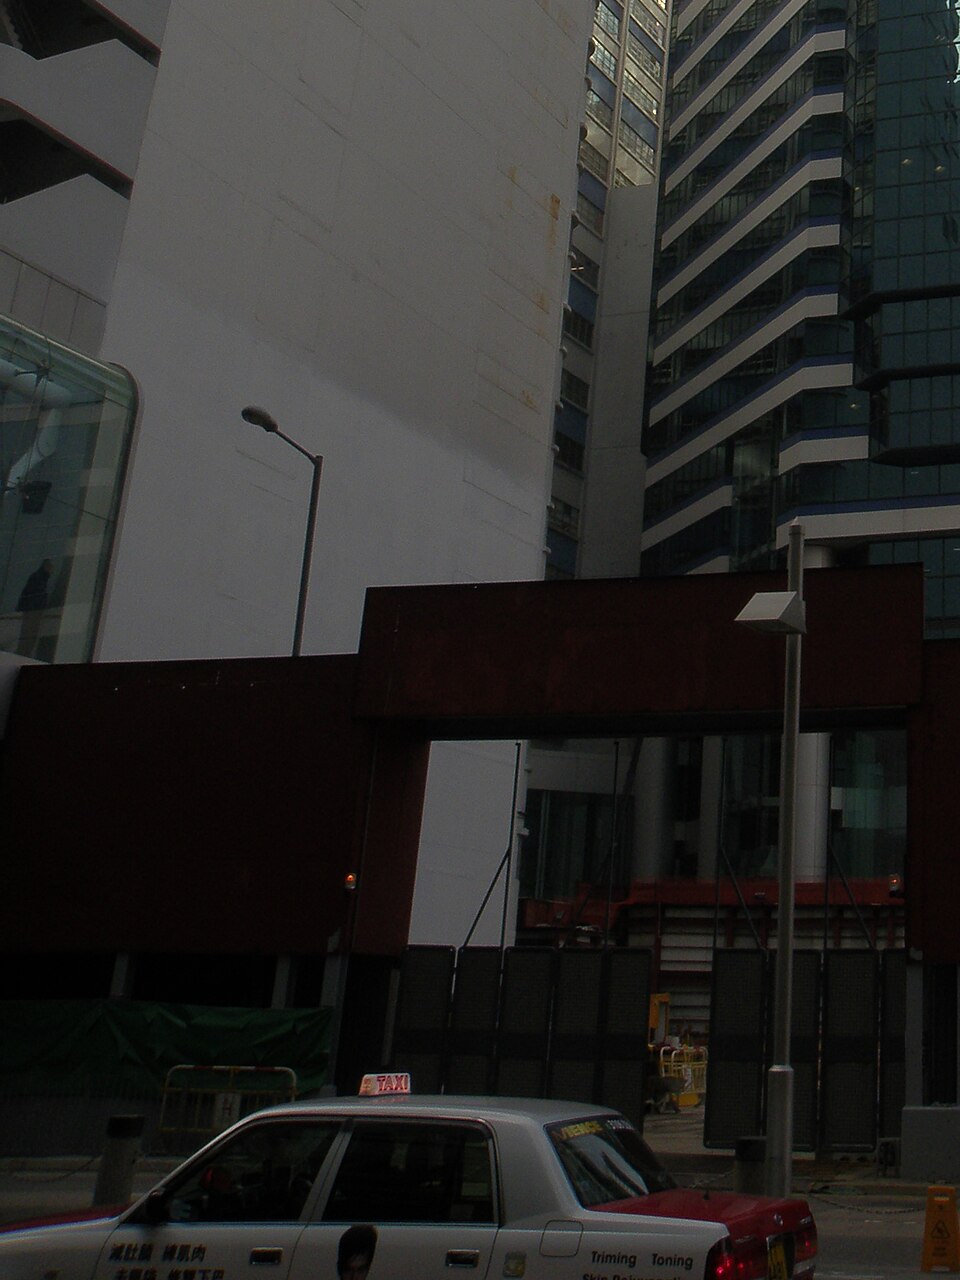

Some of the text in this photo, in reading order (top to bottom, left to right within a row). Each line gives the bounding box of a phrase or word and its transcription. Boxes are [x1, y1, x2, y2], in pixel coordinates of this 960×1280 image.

[377, 1074, 408, 1091] TAXI
[592, 1251, 694, 1270] Triming Toning
